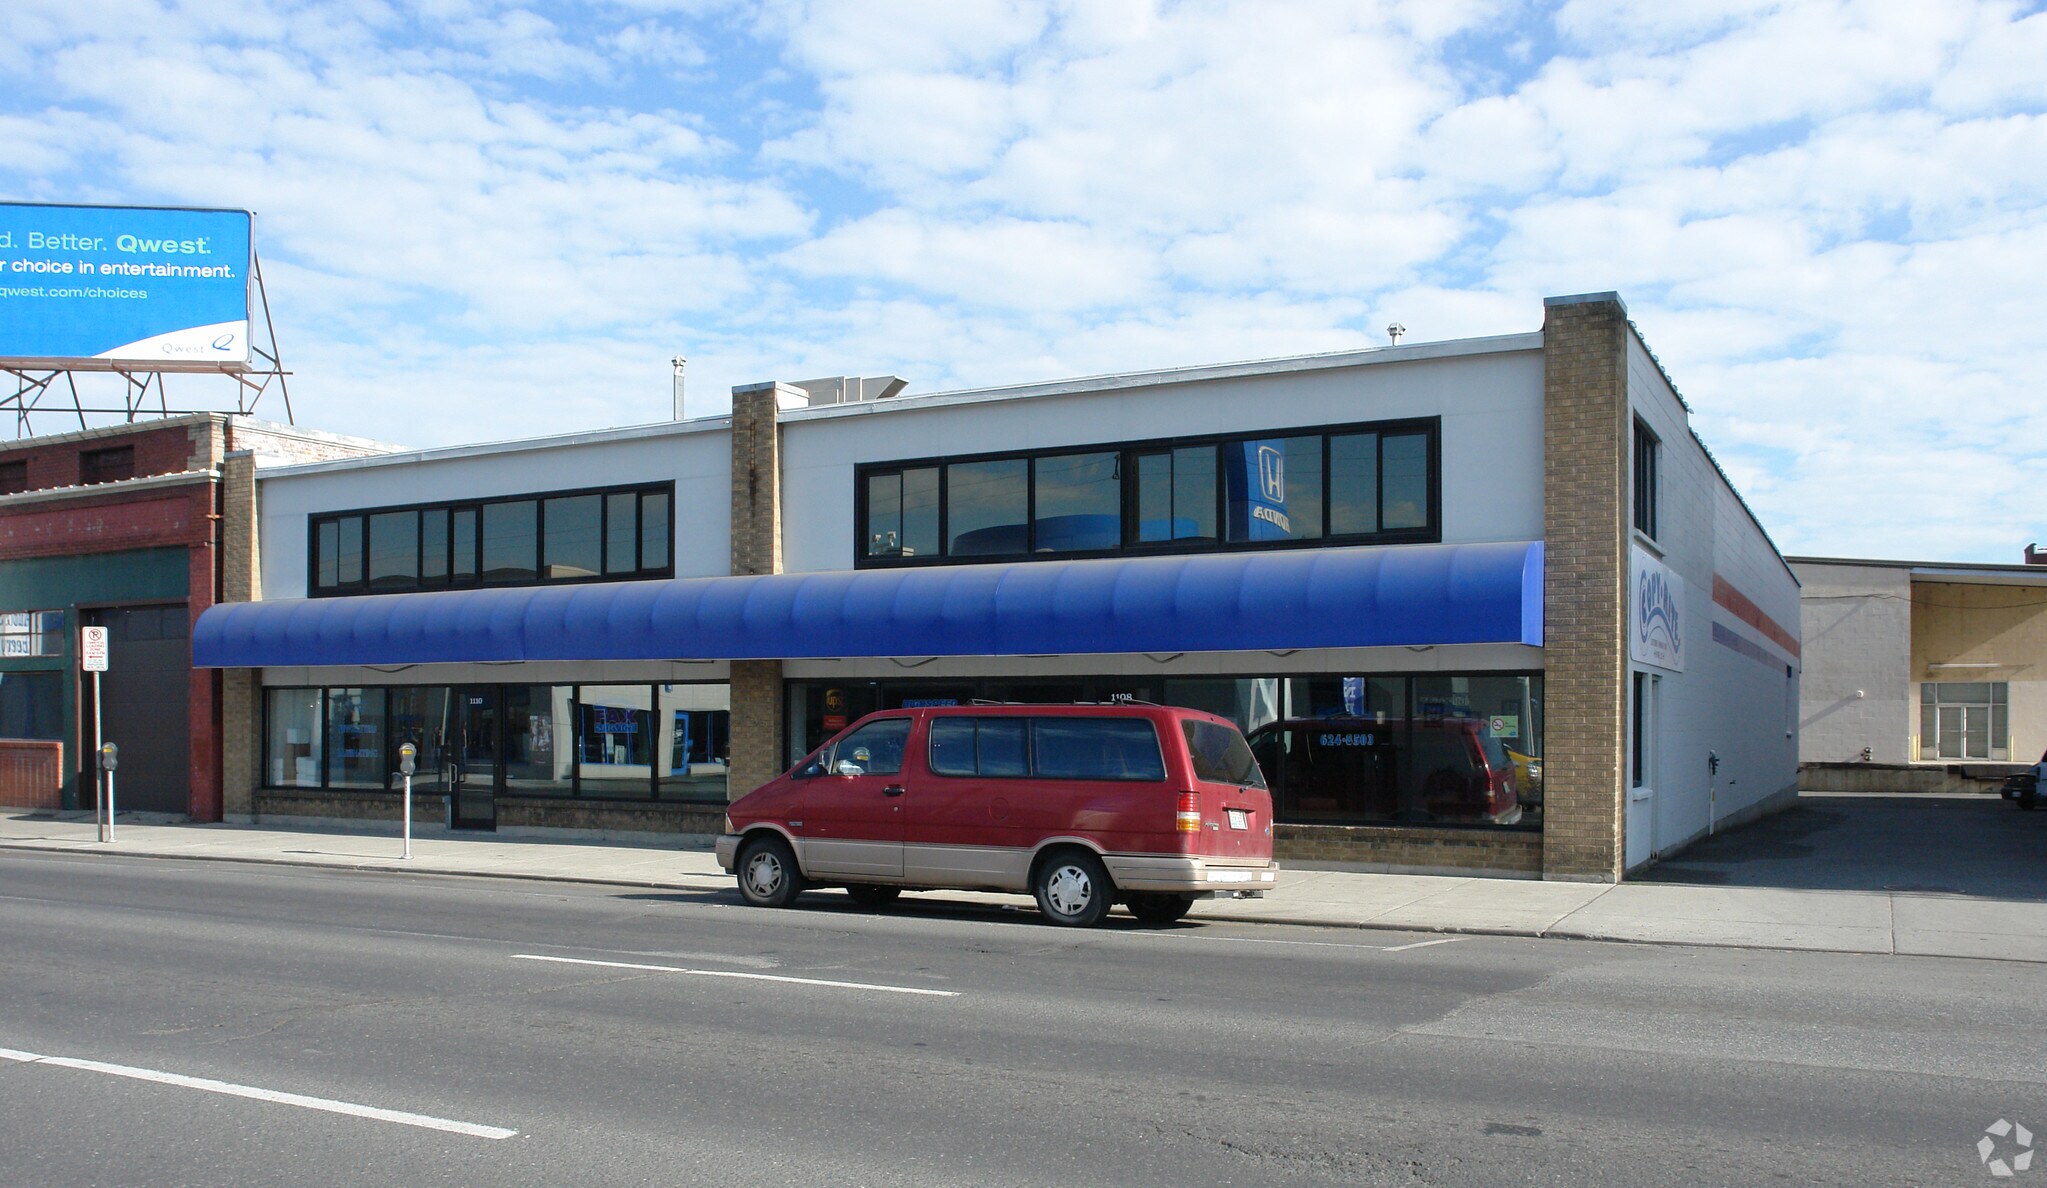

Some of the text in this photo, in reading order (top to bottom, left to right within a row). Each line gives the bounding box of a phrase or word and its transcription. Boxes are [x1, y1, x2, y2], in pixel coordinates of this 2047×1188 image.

[28, 231, 107, 251] Better.
[116, 234, 211, 254] Qwest.
[11, 258, 74, 274] choice
[79, 260, 95, 275] in
[100, 262, 236, 278] entertainment.
[0, 286, 148, 299] qwest.com/choices
[162, 343, 204, 354] Qwest
[1111, 693, 1133, 702] 1108
